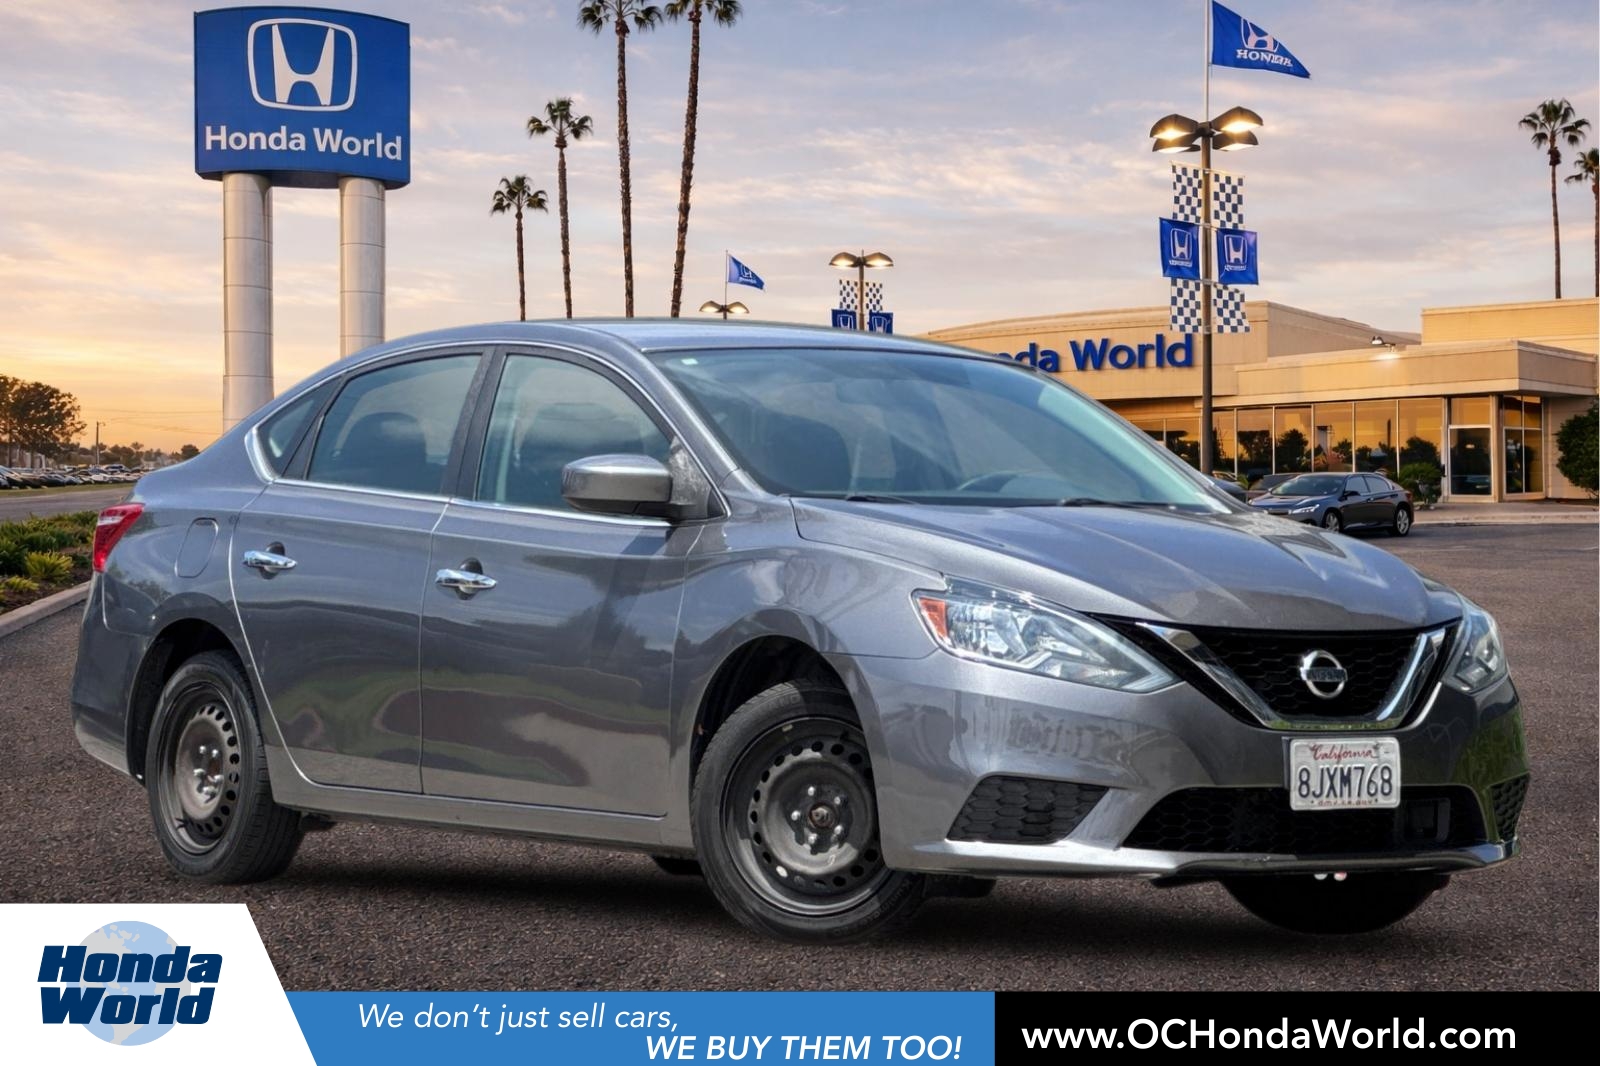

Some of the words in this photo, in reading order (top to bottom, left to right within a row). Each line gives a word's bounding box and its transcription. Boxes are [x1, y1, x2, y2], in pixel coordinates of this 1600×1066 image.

[205, 125, 306, 151] Honda
[313, 127, 402, 161] World
[1069, 333, 1193, 371] World
[1310, 743, 1379, 763] California
[1298, 766, 1393, 799] 8JXM768
